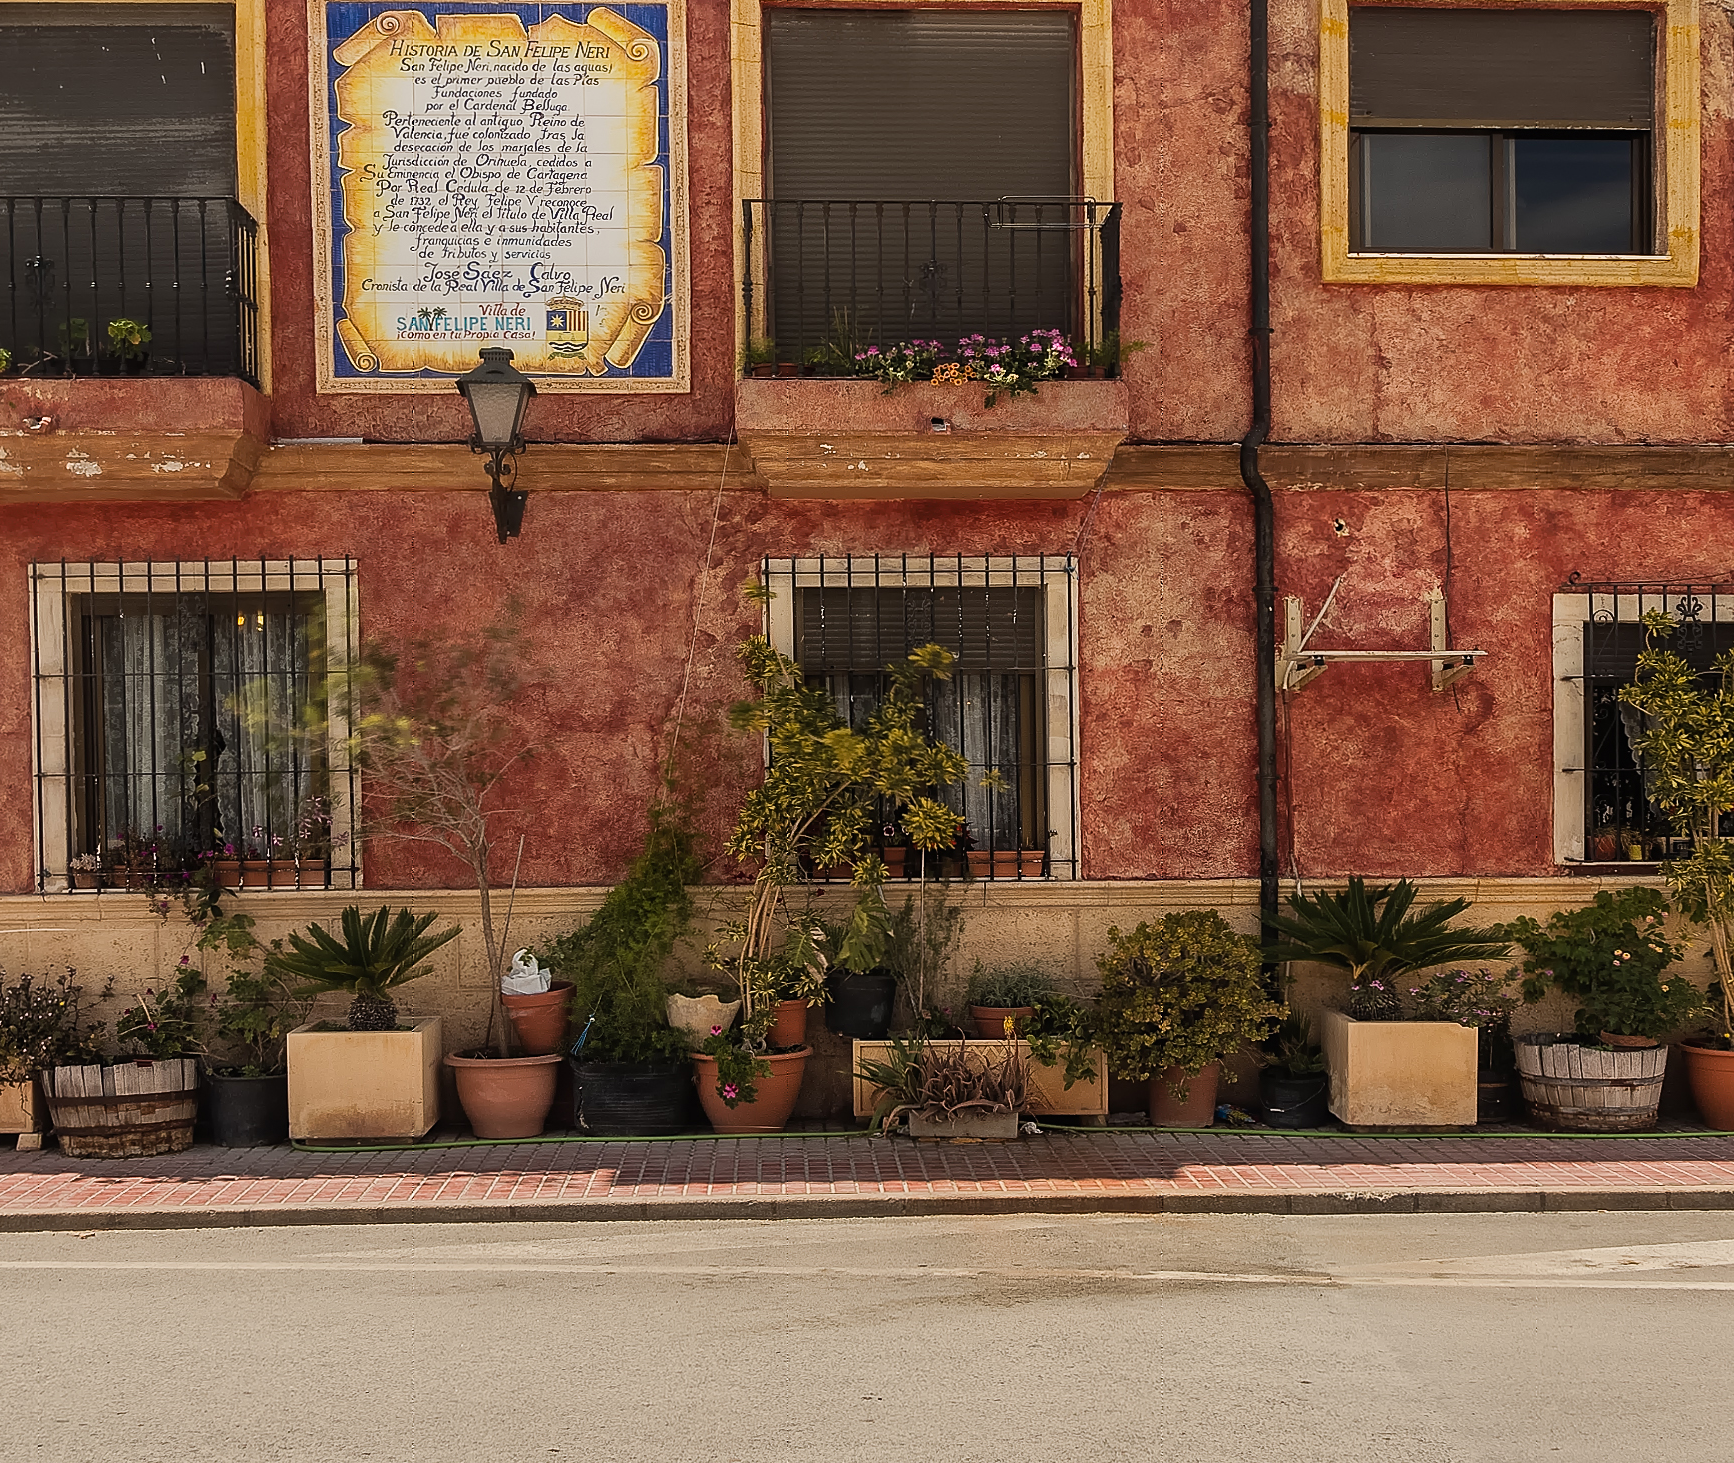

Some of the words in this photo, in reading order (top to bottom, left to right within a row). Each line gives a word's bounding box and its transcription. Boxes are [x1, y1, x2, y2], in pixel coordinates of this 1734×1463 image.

[487, 40, 520, 57] SAN
[575, 42, 610, 58] NERI
[400, 58, 425, 72] San
[429, 59, 463, 73] Felipe
[532, 58, 546, 72] de
[553, 58, 571, 72] las
[431, 75, 442, 84] el
[445, 76, 482, 86] primer
[485, 74, 525, 87] pueblo
[530, 74, 544, 85] de
[551, 74, 569, 85] las
[431, 86, 502, 99] Fundaciones
[511, 87, 557, 102] fundado
[425, 103, 445, 113] por
[449, 100, 459, 110] el
[464, 98, 516, 111] Cardenal
[383, 111, 460, 127] Perteneciente
[465, 113, 476, 126] al
[480, 114, 523, 131] antiguo
[530, 112, 566, 127] Reino
[570, 114, 585, 127] de
[472, 128, 530, 140] colonizado
[540, 128, 566, 140] tras
[572, 128, 584, 140] la
[458, 141, 471, 152] de
[478, 141, 494, 152] los
[557, 141, 572, 152] de
[575, 141, 588, 153] la
[454, 155, 467, 166] de
[537, 156, 578, 167] cedidos
[360, 165, 385, 182] Su
[445, 167, 455, 179] el
[460, 167, 501, 182] Obispo
[507, 168, 521, 180] de
[526, 168, 588, 185] Cartagena
[376, 180, 402, 197] Por
[406, 180, 438, 193] Real
[495, 181, 510, 194] de
[516, 185, 525, 193] 12
[529, 182, 543, 194] de
[544, 182, 591, 196] Febrero
[390, 195, 405, 206] de
[439, 195, 448, 206] el
[452, 194, 478, 208] Rey
[487, 195, 522, 209] Felipe
[526, 195, 538, 206] V
[539, 198, 587, 212] reconoce
[383, 204, 409, 221] San
[412, 206, 450, 223] Felipe
[451, 206, 478, 223] Neri
[482, 206, 493, 218] el
[532, 207, 546, 220] de
[546, 207, 580, 220] Villa
[582, 206, 614, 225] Real
[372, 223, 383, 237] y
[390, 221, 400, 232] le
[460, 221, 482, 233] ella
[485, 225, 495, 235] y
[410, 234, 479, 252] franquicias
[497, 235, 572, 247] inmunidades
[419, 248, 434, 259] de
[441, 248, 486, 259] tributos
[489, 251, 498, 263] y
[423, 262, 460, 282] José
[463, 261, 513, 281] Sáez
[530, 262, 571, 281] Calvo
[362, 277, 408, 292] Cronista
[413, 280, 427, 291] de
[430, 280, 442, 292] la
[443, 280, 478, 296] Real
[481, 279, 509, 293] Villa
[512, 280, 525, 291] de
[523, 280, 554, 298] San
[556, 281, 593, 296] Felipe
[594, 277, 626, 299] Neri
[479, 303, 510, 316] Villa
[513, 303, 526, 316] de
[397, 317, 428, 331] SAN
[495, 317, 531, 331] NERI
[450, 331, 461, 339] tu
[463, 330, 498, 340] Propia
[504, 330, 536, 340] Casa!
